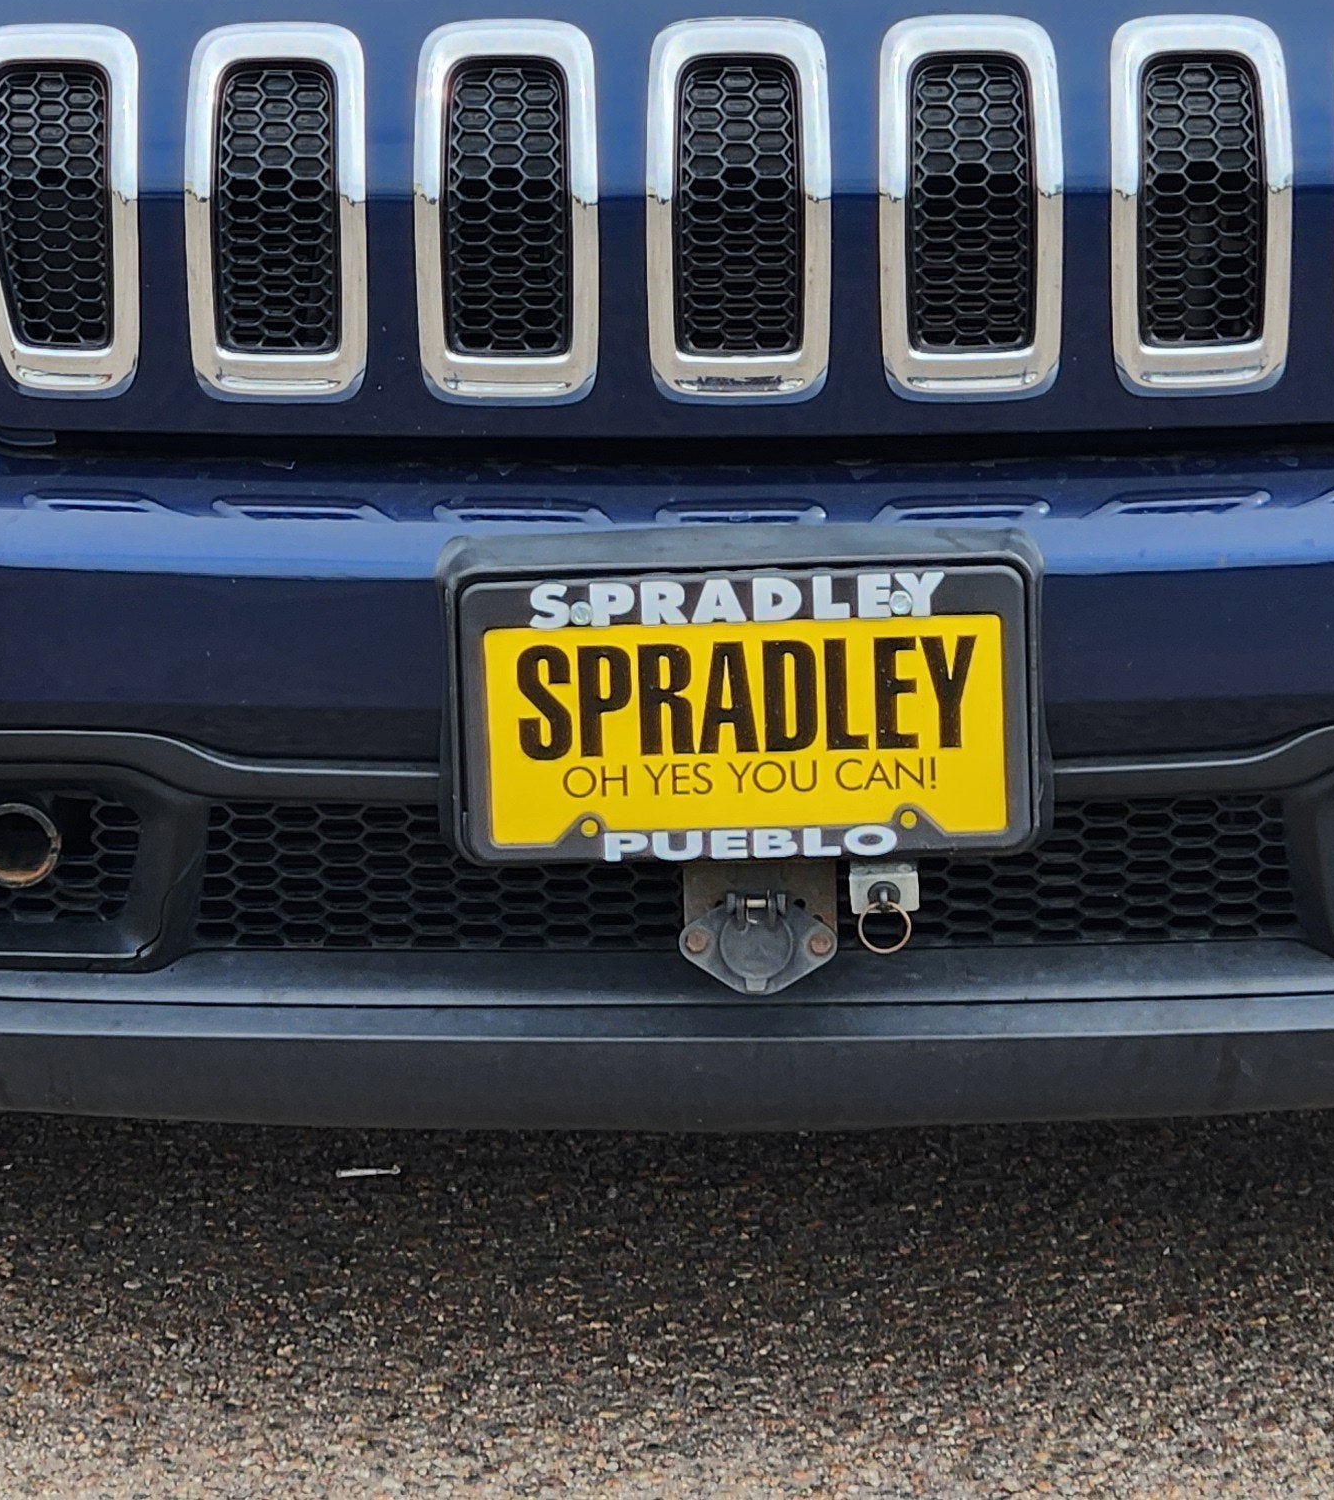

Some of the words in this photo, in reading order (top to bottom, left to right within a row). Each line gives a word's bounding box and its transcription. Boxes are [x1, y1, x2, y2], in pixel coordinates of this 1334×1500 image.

[516, 634, 978, 761] SPRADLEY
[562, 764, 628, 798] OH
[643, 763, 713, 795] YES
[727, 760, 818, 793] YOU
[835, 756, 938, 791] CAN!
[603, 825, 898, 862] PUEBLO
